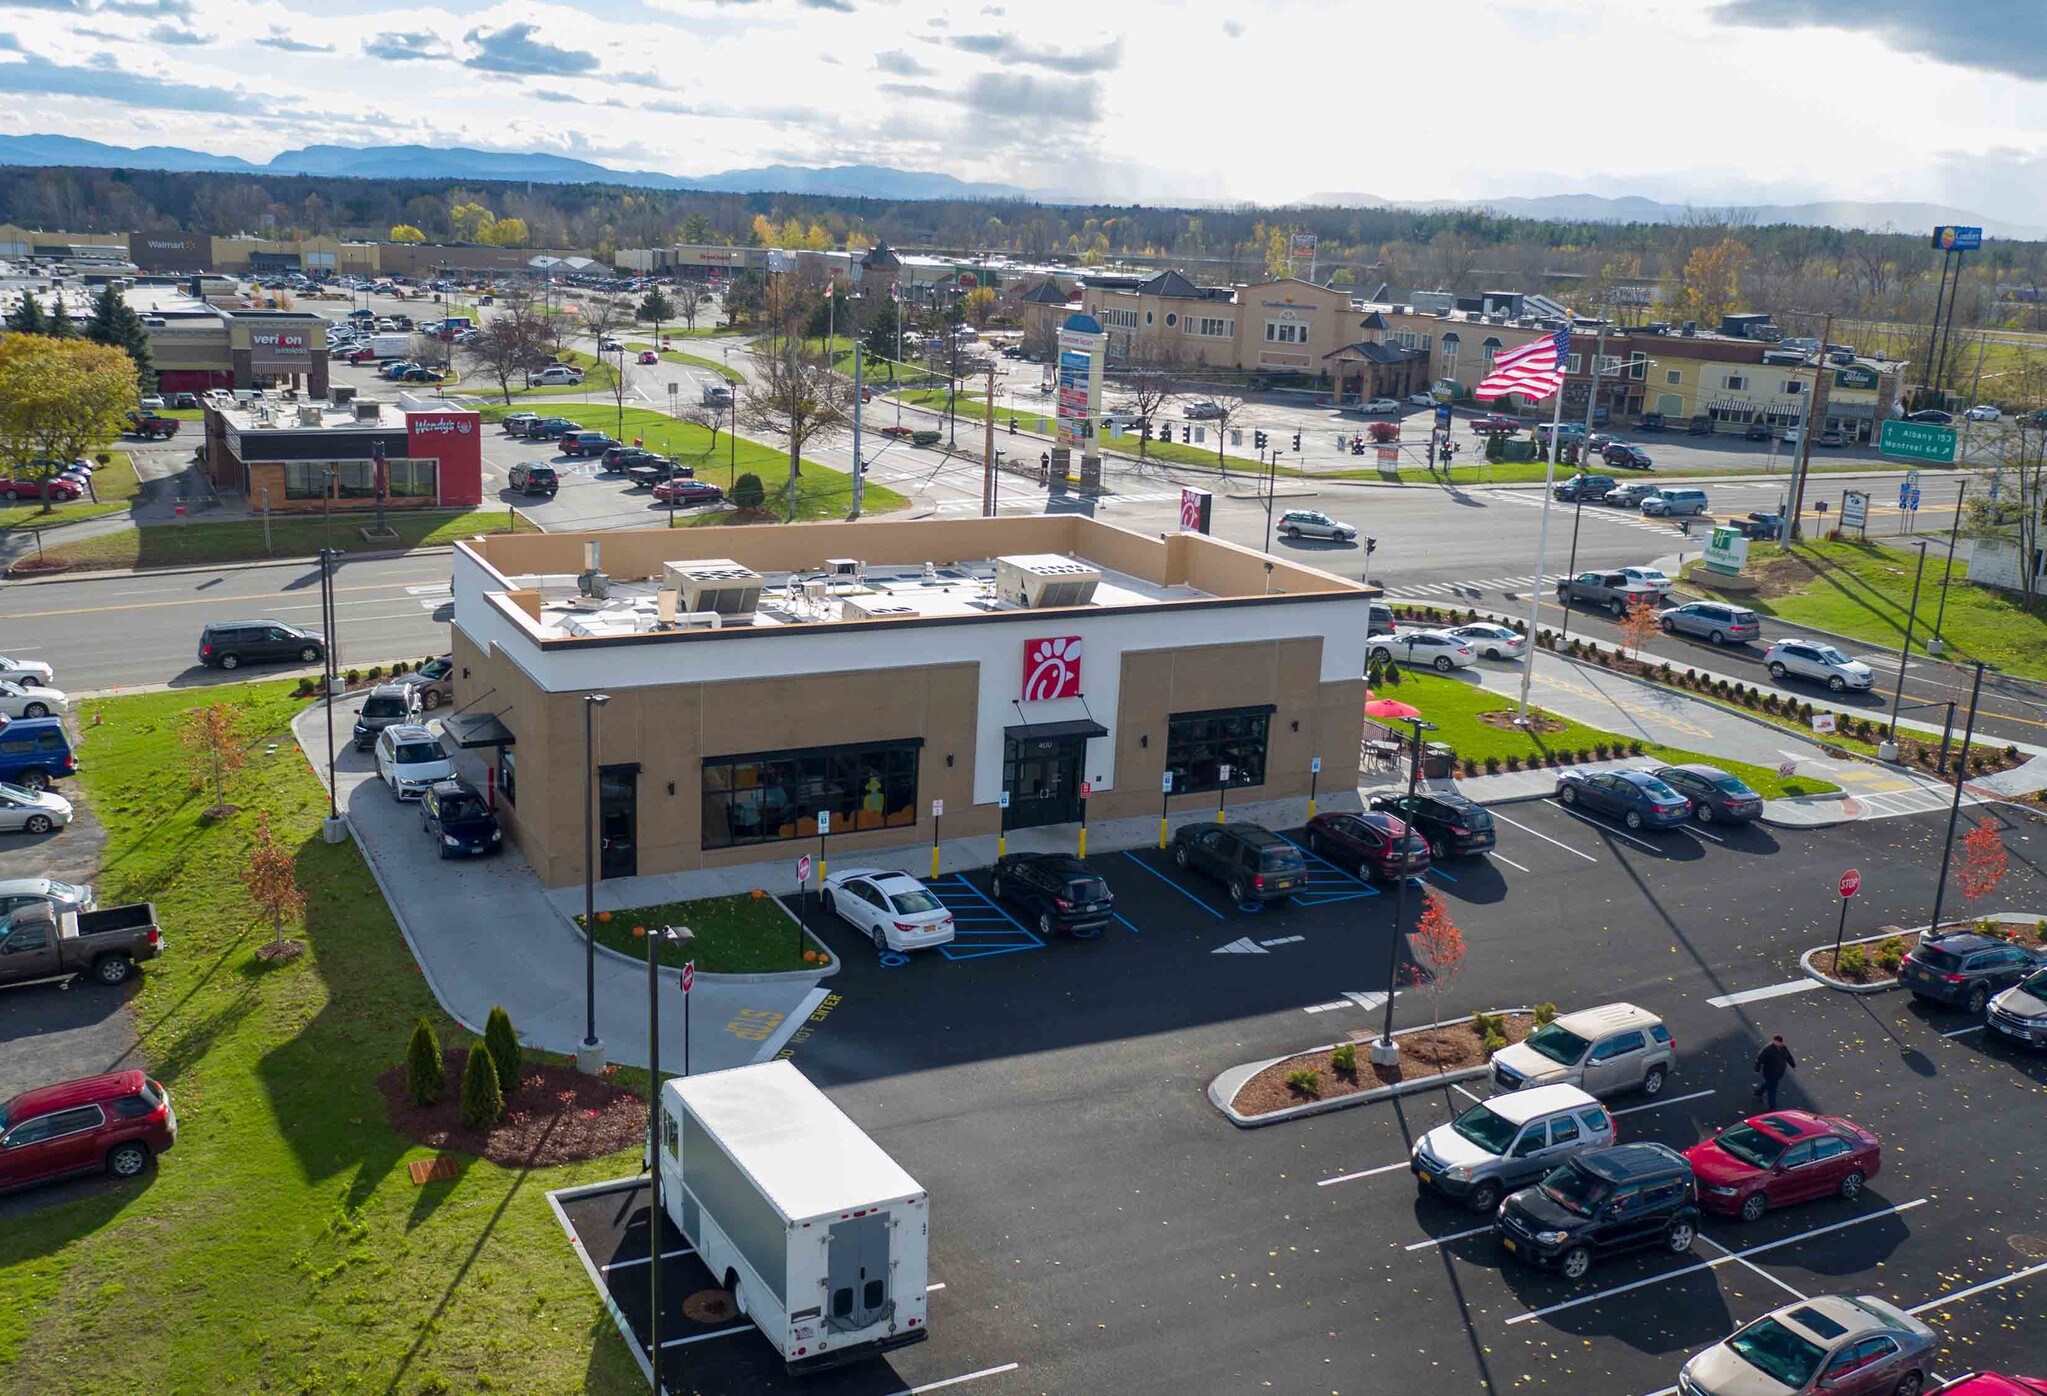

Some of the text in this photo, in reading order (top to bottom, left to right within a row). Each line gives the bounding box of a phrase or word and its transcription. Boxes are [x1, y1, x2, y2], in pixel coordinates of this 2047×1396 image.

[147, 240, 185, 249] Walmart
[414, 417, 455, 435] Wendy's
[1903, 430, 1952, 443] Albany 153
[1885, 440, 1938, 454] Montreal 64
[1705, 546, 1739, 562] Holiday Inn
[1840, 877, 1859, 890] STOP
[789, 1025, 815, 1044] NOT
[809, 994, 843, 1022] ENTER
